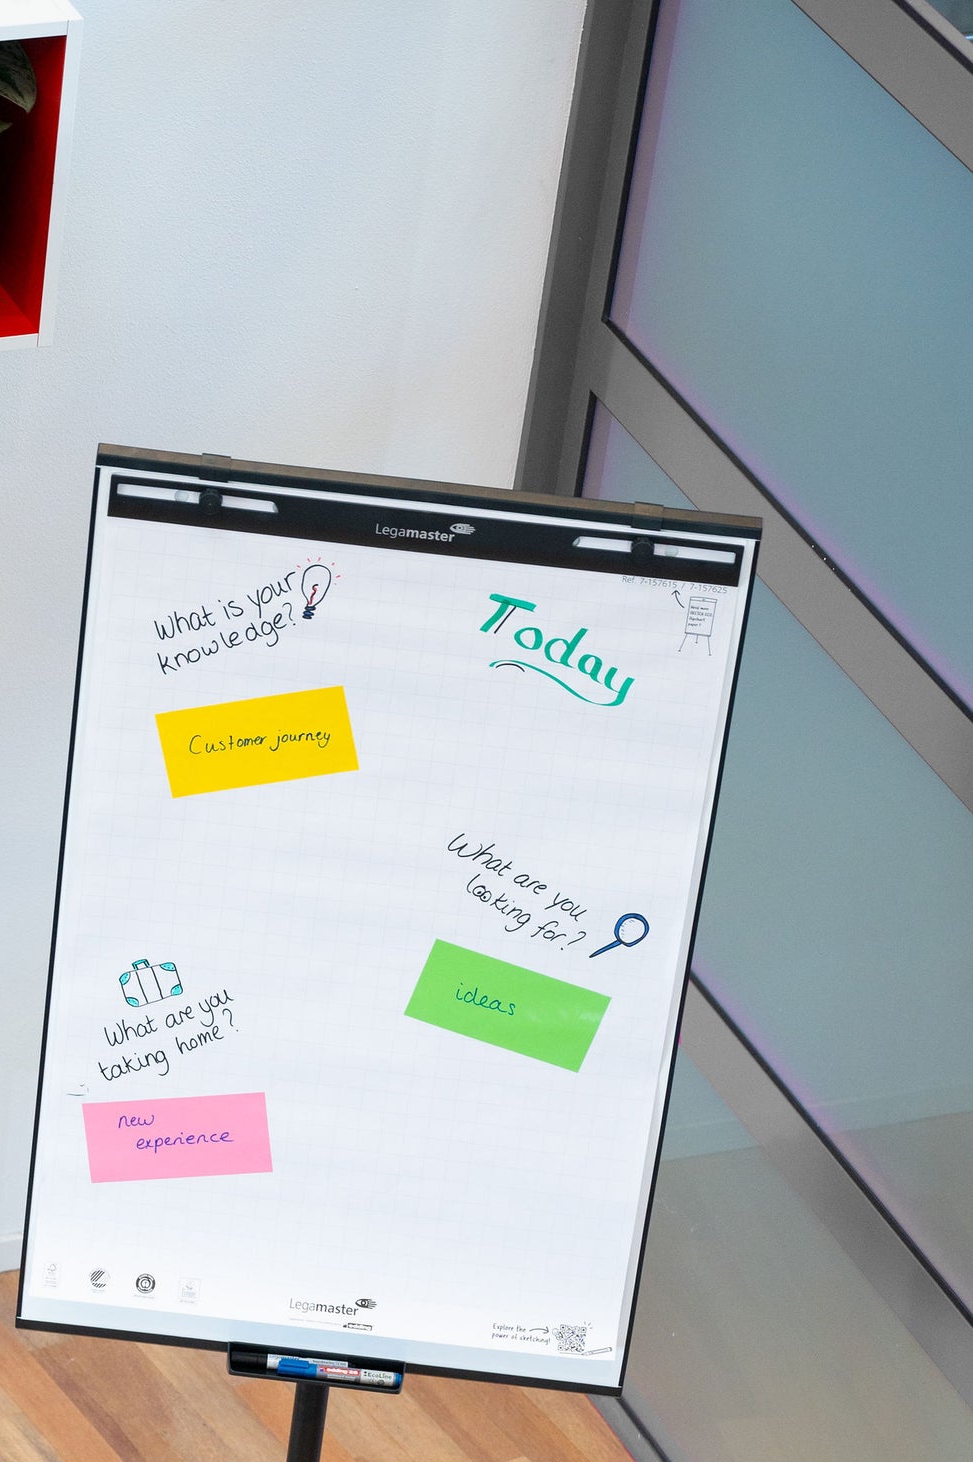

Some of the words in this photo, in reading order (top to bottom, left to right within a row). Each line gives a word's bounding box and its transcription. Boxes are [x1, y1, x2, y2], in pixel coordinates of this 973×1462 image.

[375, 523, 455, 542] Legamaster
[621, 575, 635, 584] Ref.
[639, 578, 678, 589] 7-157615
[689, 583, 728, 594] 7-157625
[153, 605, 216, 641] What
[218, 599, 244, 620] is
[246, 571, 296, 619] your
[479, 593, 635, 707] Today
[189, 734, 268, 755] Customer
[269, 729, 331, 752] journey
[447, 833, 512, 877] What
[513, 873, 548, 895] are
[544, 892, 587, 922] you
[466, 873, 532, 933] looking
[455, 981, 516, 1016] ideas
[103, 1015, 158, 1047] What
[165, 1005, 195, 1029] are
[198, 989, 235, 1028] you
[98, 1049, 170, 1082] taking
[118, 1114, 155, 1129] new
[136, 1131, 235, 1154] experience
[289, 1297, 359, 1316] Legamaster
[491, 1332, 508, 1340] power
[492, 1323, 514, 1331] Explore
[516, 1324, 526, 1332] the
